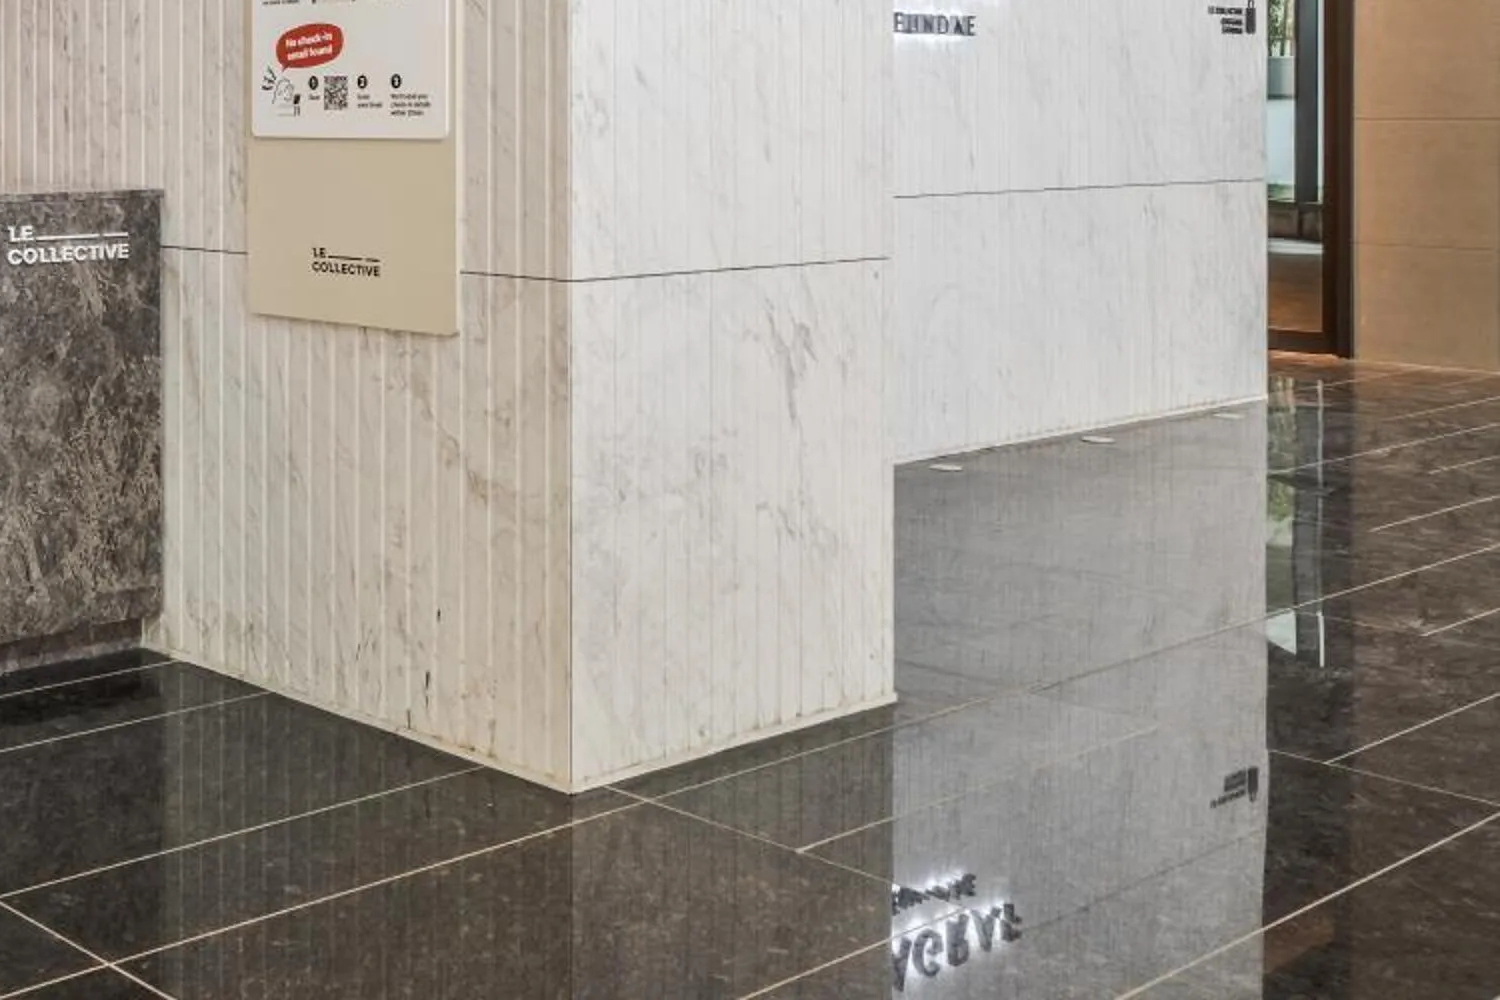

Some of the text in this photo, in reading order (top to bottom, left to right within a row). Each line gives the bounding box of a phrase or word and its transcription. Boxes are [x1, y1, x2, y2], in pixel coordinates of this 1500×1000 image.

[7, 225, 35, 241] LE
[7, 243, 129, 265] COLLECTIVE
[312, 247, 326, 258] LE
[311, 261, 381, 277] COLLECTIVE
